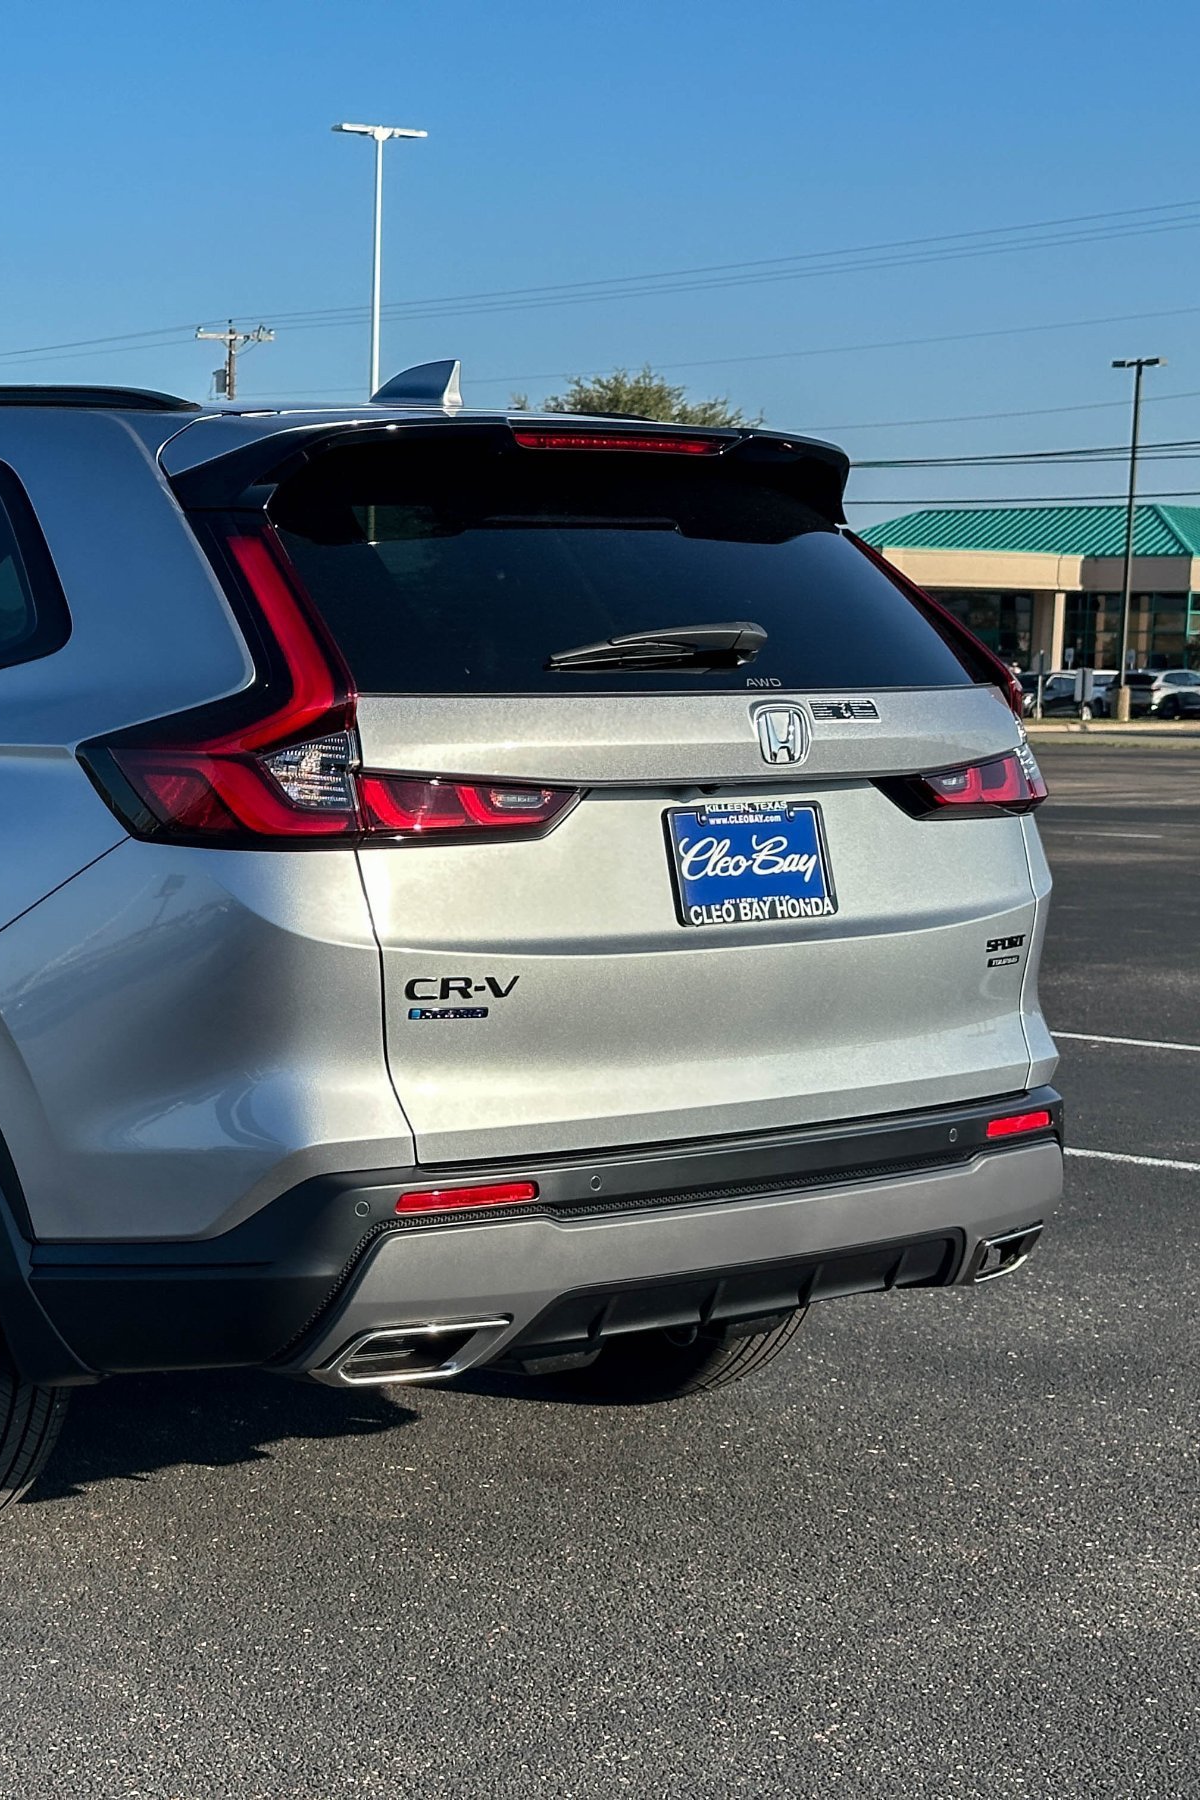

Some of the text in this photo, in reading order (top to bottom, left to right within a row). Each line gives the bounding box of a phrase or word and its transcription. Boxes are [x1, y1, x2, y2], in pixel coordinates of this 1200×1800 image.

[746, 678, 782, 687] AWD
[705, 801, 788, 814] KILLEEN, TEXAS
[709, 814, 781, 825] www.CLEOBAY.com
[679, 835, 817, 882] Cleo Bay
[690, 896, 835, 925] CLEO BAY HONDA
[986, 934, 1026, 953] SPORT
[404, 975, 520, 1000] CR-V
